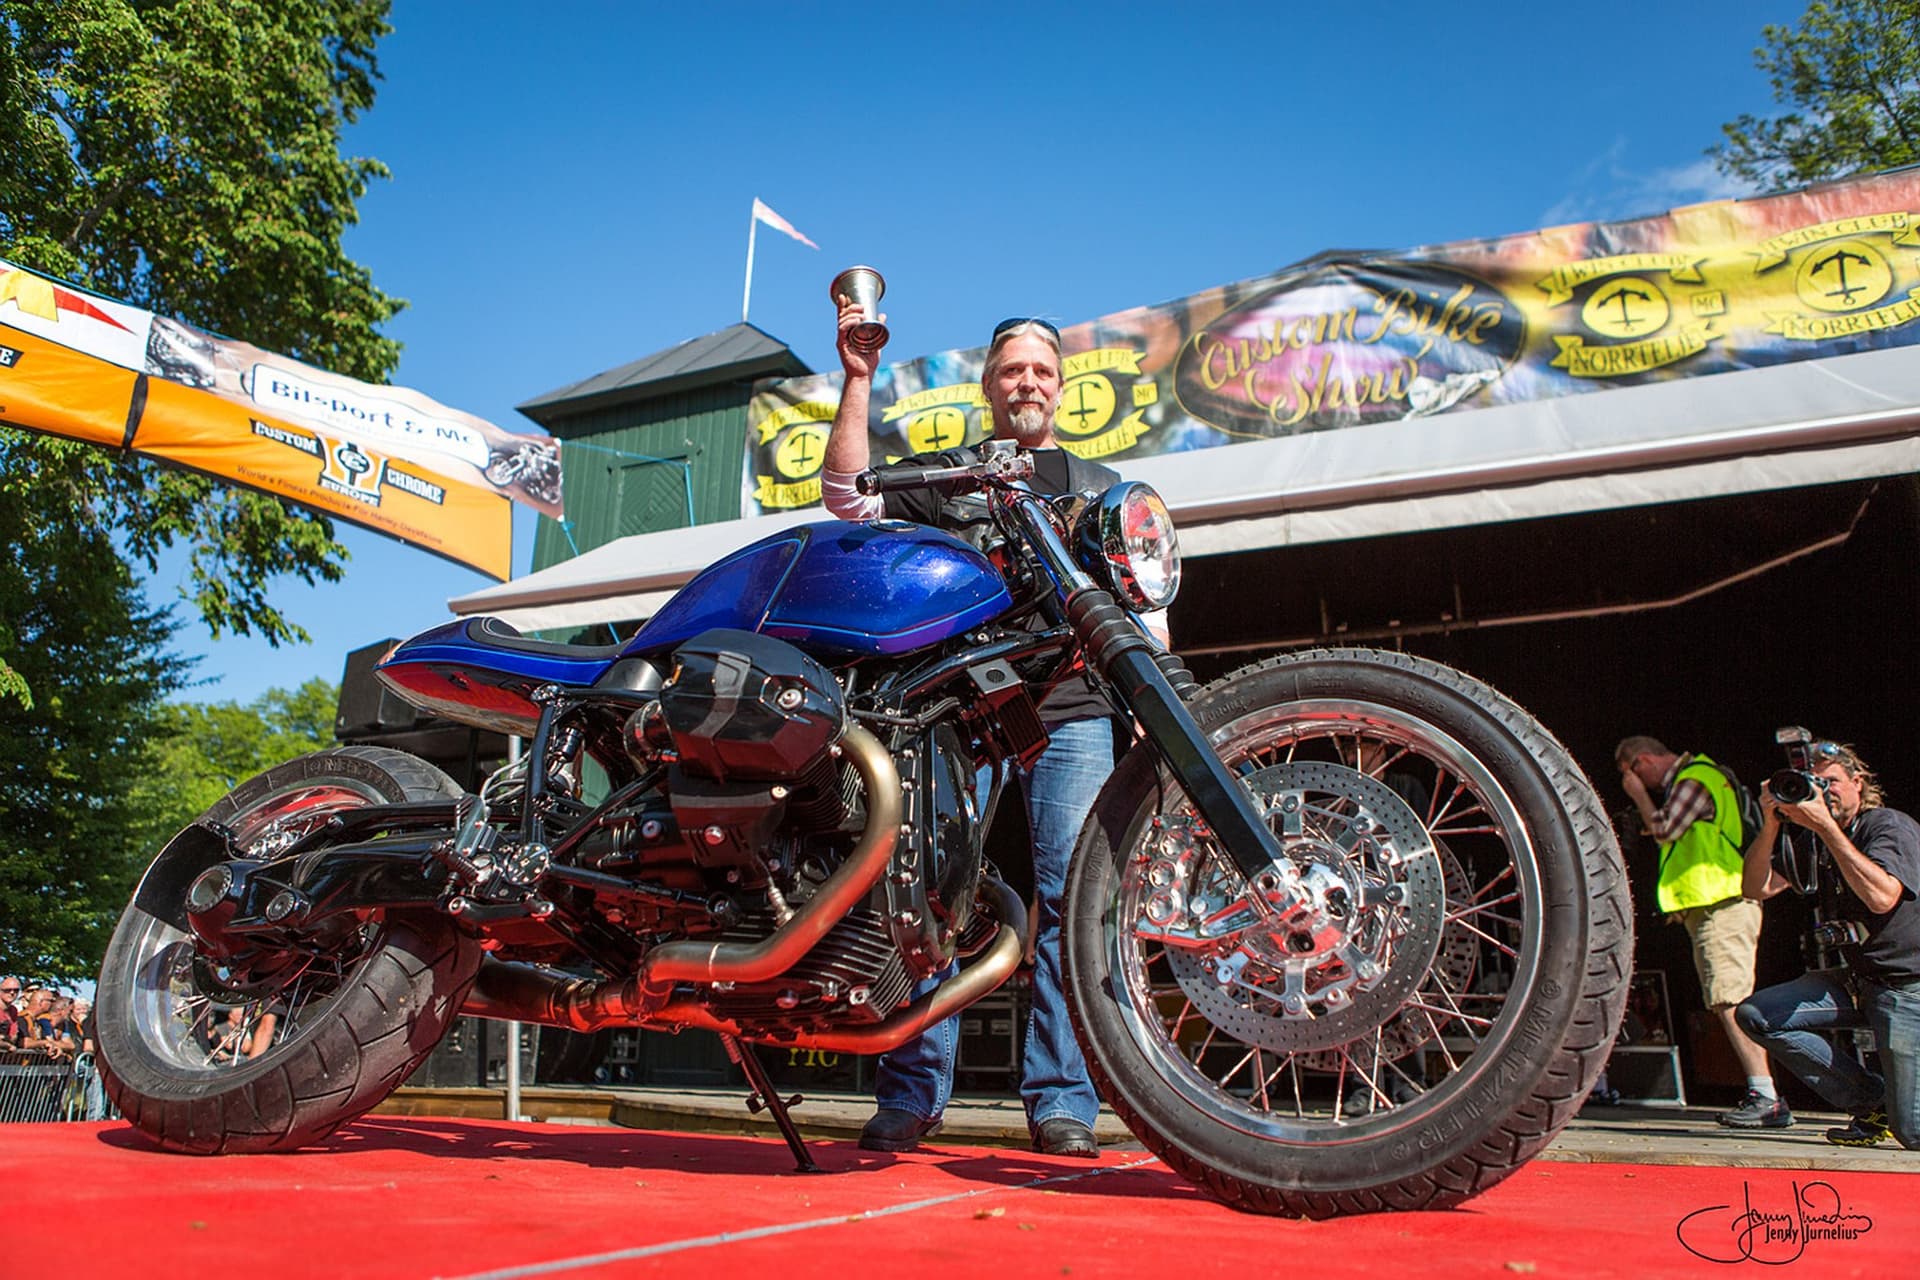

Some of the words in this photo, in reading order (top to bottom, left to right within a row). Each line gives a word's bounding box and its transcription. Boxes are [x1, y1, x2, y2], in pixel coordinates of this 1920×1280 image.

[1836, 214, 1906, 234] CLUB
[1696, 296, 1719, 312] MC
[1195, 306, 1359, 391] Custom
[1357, 284, 1504, 344] Bike
[1245, 338, 1434, 425] Show
[271, 380, 394, 428] Bilsport
[255, 421, 319, 454] CUSTOM
[320, 478, 380, 507] EUROPE
[386, 467, 443, 504] CHROME
